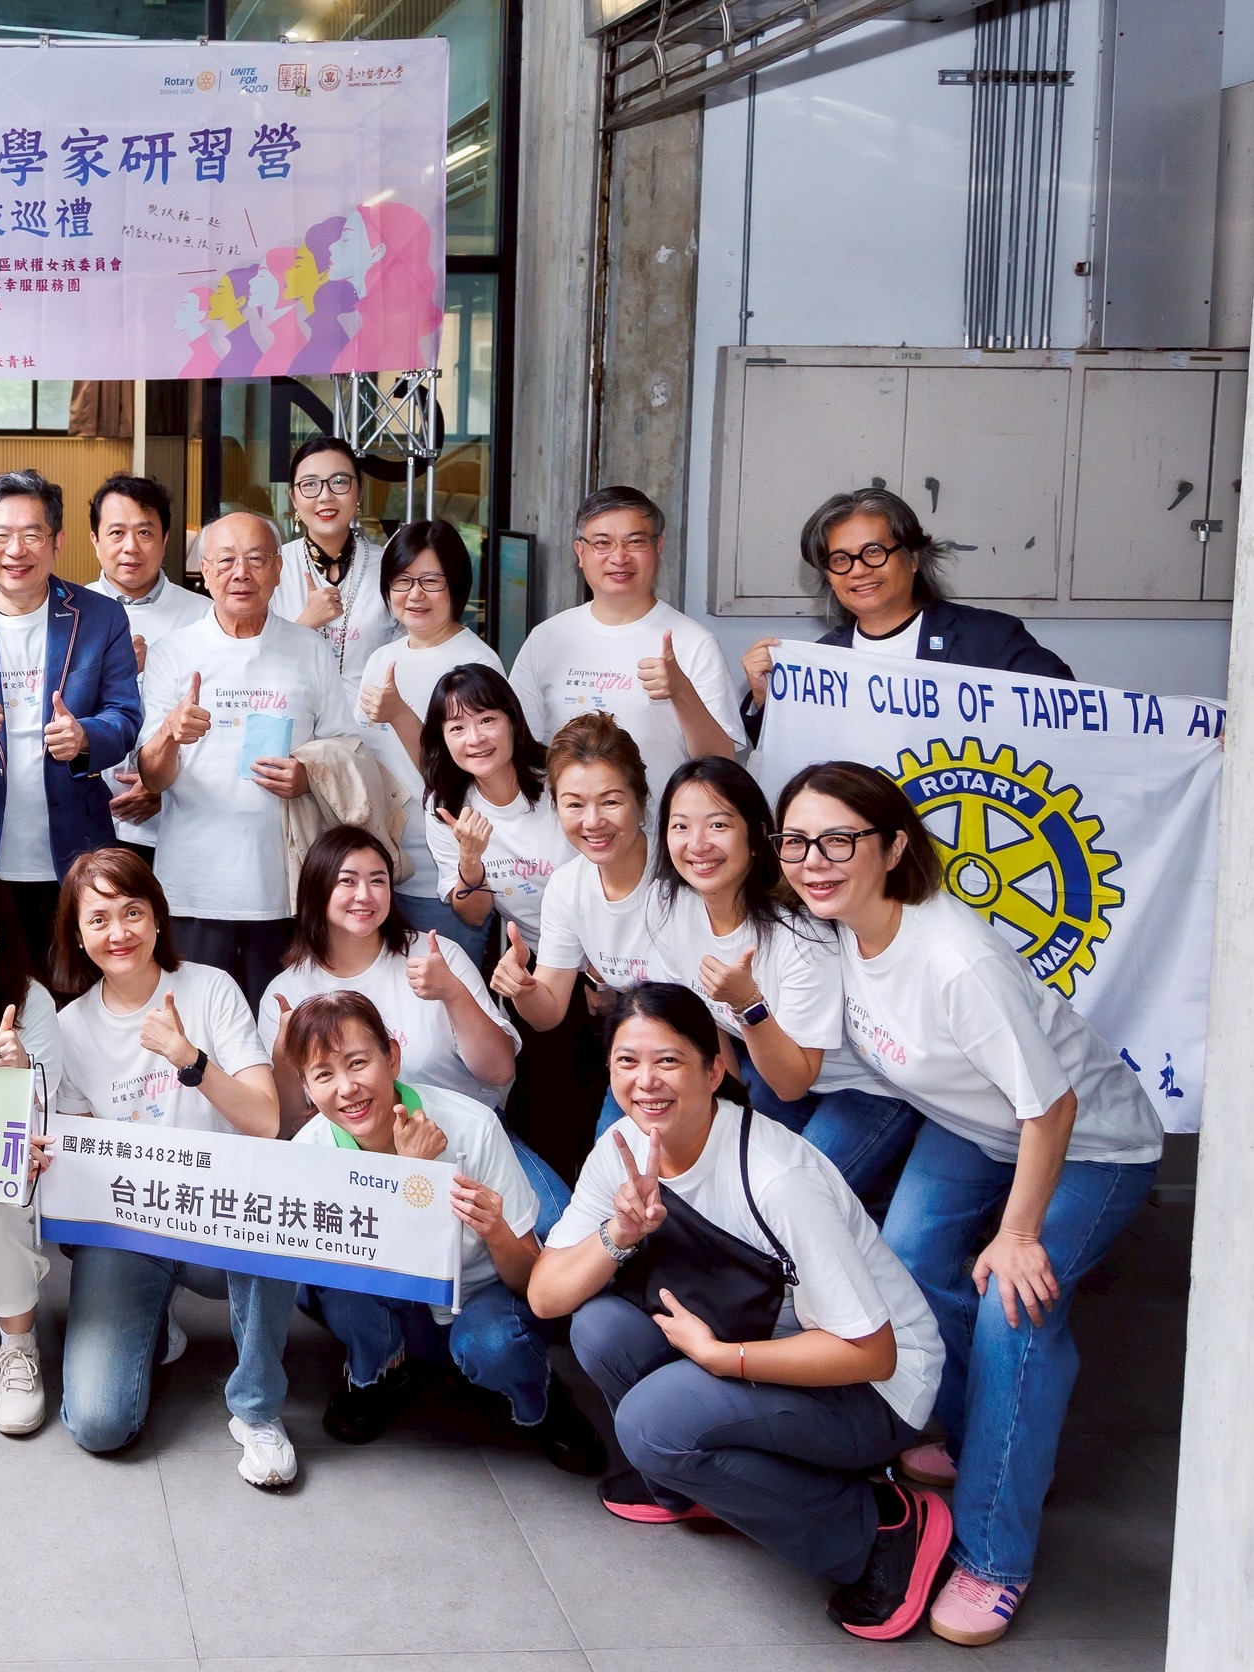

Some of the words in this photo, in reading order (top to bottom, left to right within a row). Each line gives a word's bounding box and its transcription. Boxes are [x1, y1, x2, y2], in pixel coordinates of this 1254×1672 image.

[164, 77, 194, 87] Rotary
[230, 67, 257, 76] UNITE
[241, 85, 268, 93] GOOD
[568, 667, 622, 680] Empowering
[595, 673, 634, 693] Girls
[215, 687, 274, 699] Empowering
[248, 691, 288, 711] Girls
[771, 662, 848, 708] OTARY
[868, 674, 940, 719] CLUB
[957, 681, 995, 723] OF
[1011, 686, 1108, 732] TAIPEI
[1123, 692, 1163, 734] TA
[918, 770, 1031, 805] ROTARY
[483, 857, 537, 869] mpowering
[515, 858, 554, 880] Girls
[112, 1069, 168, 1091] Empowering
[62, 1134, 212, 1169] 國際扶輪3482地區
[349, 1170, 399, 1194] Rotary
[110, 1174, 379, 1240] 台北新世紀扶輪社
[115, 1206, 161, 1229] Rotary
[166, 1215, 198, 1233] Club
[202, 1221, 218, 1236] of
[224, 1223, 270, 1244] Taipei
[275, 1231, 309, 1249] New
[314, 1236, 378, 1261] Century
